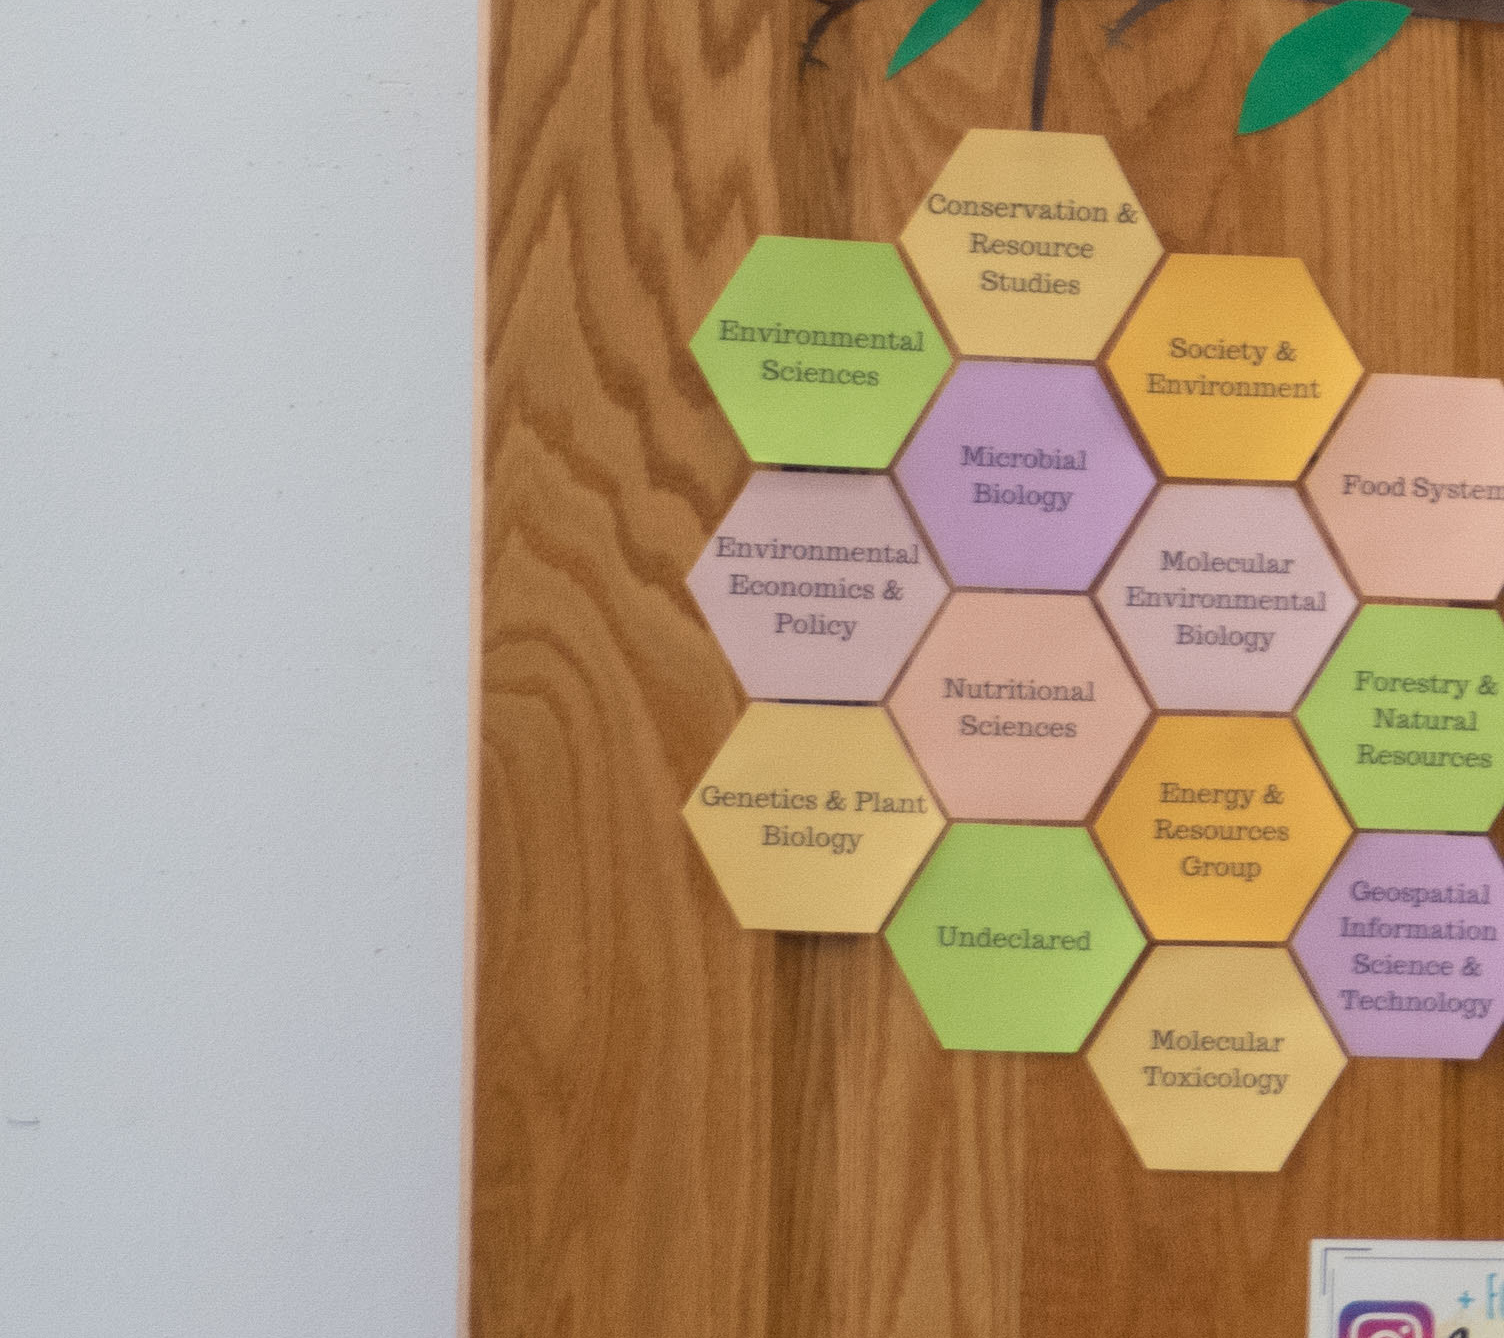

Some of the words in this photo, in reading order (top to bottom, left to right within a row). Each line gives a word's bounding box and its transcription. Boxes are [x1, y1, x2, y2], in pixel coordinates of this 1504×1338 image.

[926, 192, 1111, 226] Conservation
[1117, 203, 1138, 227] &
[968, 232, 1094, 262] Resource
[979, 269, 1081, 297] Studies
[719, 322, 924, 353] Environmental
[1169, 337, 1268, 367] Society
[1275, 340, 1297, 363] &
[761, 359, 879, 387] Sciences
[1147, 373, 1321, 401] Environment
[961, 443, 1087, 473] Microbial
[972, 481, 1073, 515] Biology
[1342, 473, 1405, 502] Food
[716, 536, 921, 567] Environmental
[1160, 549, 1295, 577] Molecular
[728, 574, 876, 602] Economics
[883, 579, 904, 602] &
[1125, 586, 1327, 614] Environmental
[774, 609, 858, 642] Policy
[1176, 622, 1275, 653] Biology
[944, 676, 1095, 704] Nutritional
[1355, 670, 1469, 702] Forestry
[1477, 674, 1498, 697] &
[960, 713, 1077, 740] Sciences
[1373, 706, 1478, 733] Natural
[1357, 743, 1492, 771] Resources
[700, 786, 817, 813] Genetics
[826, 789, 847, 813] &
[854, 791, 928, 816] Plant
[1160, 781, 1255, 813] Energy
[1263, 783, 1284, 807] &
[761, 824, 863, 856] Biology
[1154, 817, 1289, 843] Resources
[1180, 855, 1262, 886] Group
[1350, 879, 1492, 909] Geospatial
[937, 926, 1092, 952] Undeclared
[1340, 915, 1497, 942] Information
[1353, 952, 1451, 979] Science
[1460, 953, 1482, 979] &
[1340, 987, 1492, 1021] Technology
[1150, 1028, 1284, 1055] Molecular
[1144, 1066, 1289, 1099] Toxicology
